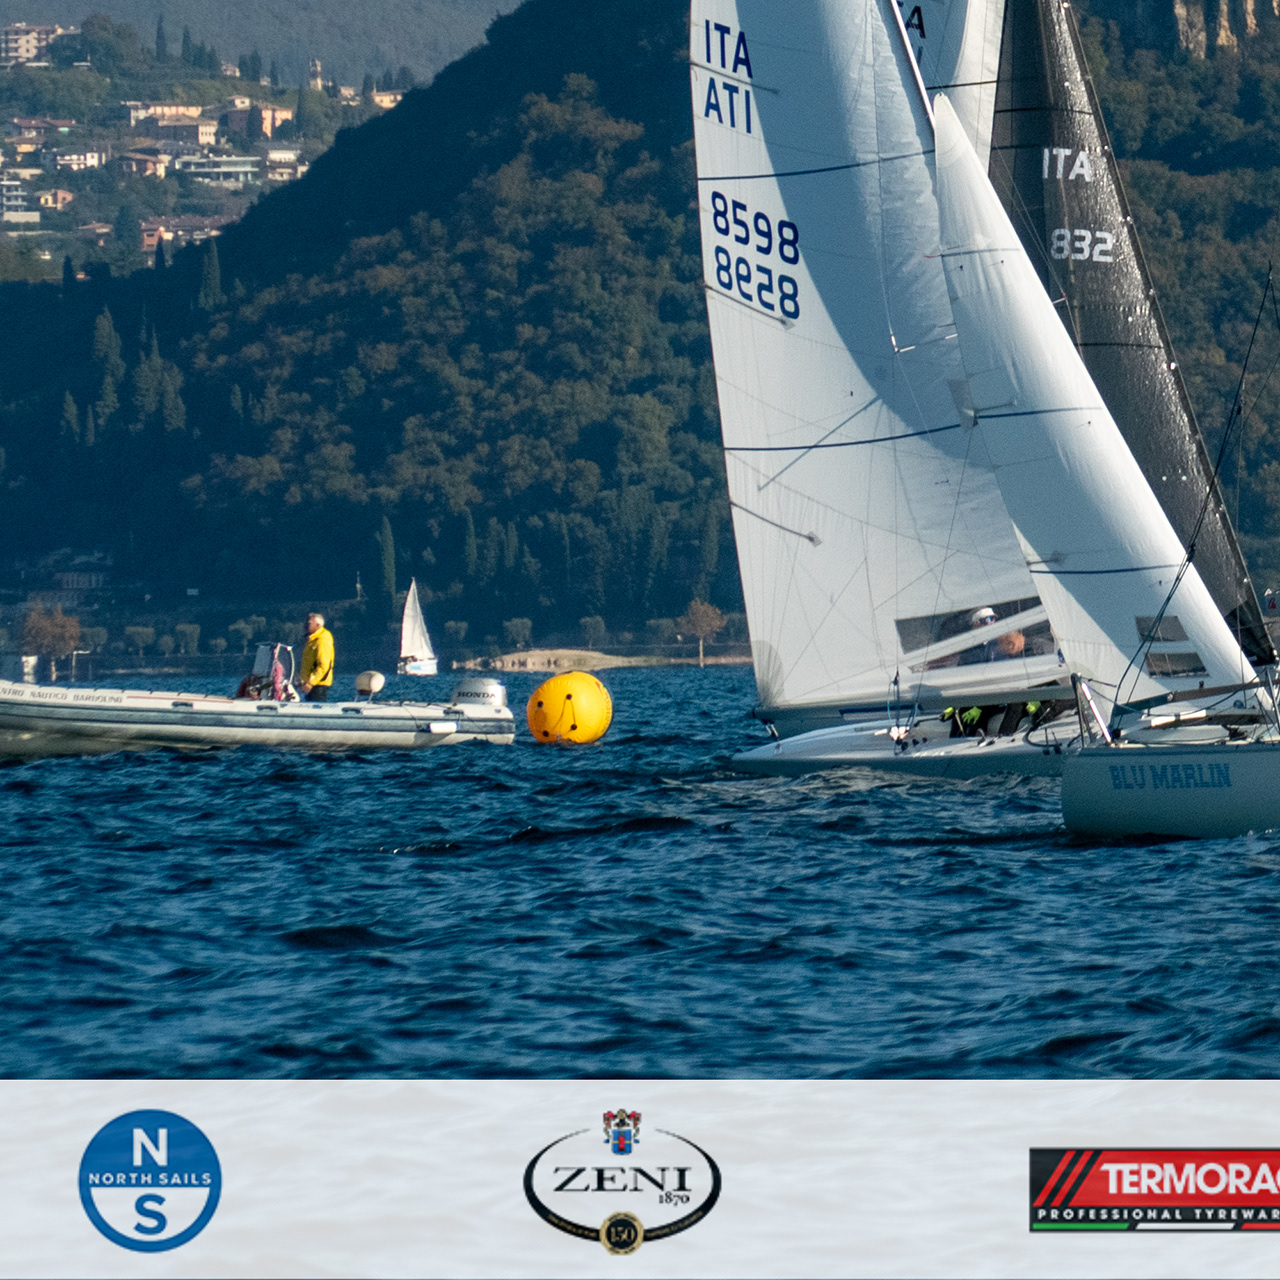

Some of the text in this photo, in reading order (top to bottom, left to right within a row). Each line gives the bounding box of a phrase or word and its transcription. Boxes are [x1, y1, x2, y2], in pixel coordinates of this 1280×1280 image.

[705, 19, 753, 79] ITA
[1042, 148, 1092, 182] ITA
[711, 191, 800, 265] 8598
[1051, 228, 1113, 262] 832
[1109, 764, 1232, 789] BLU MARLIN
